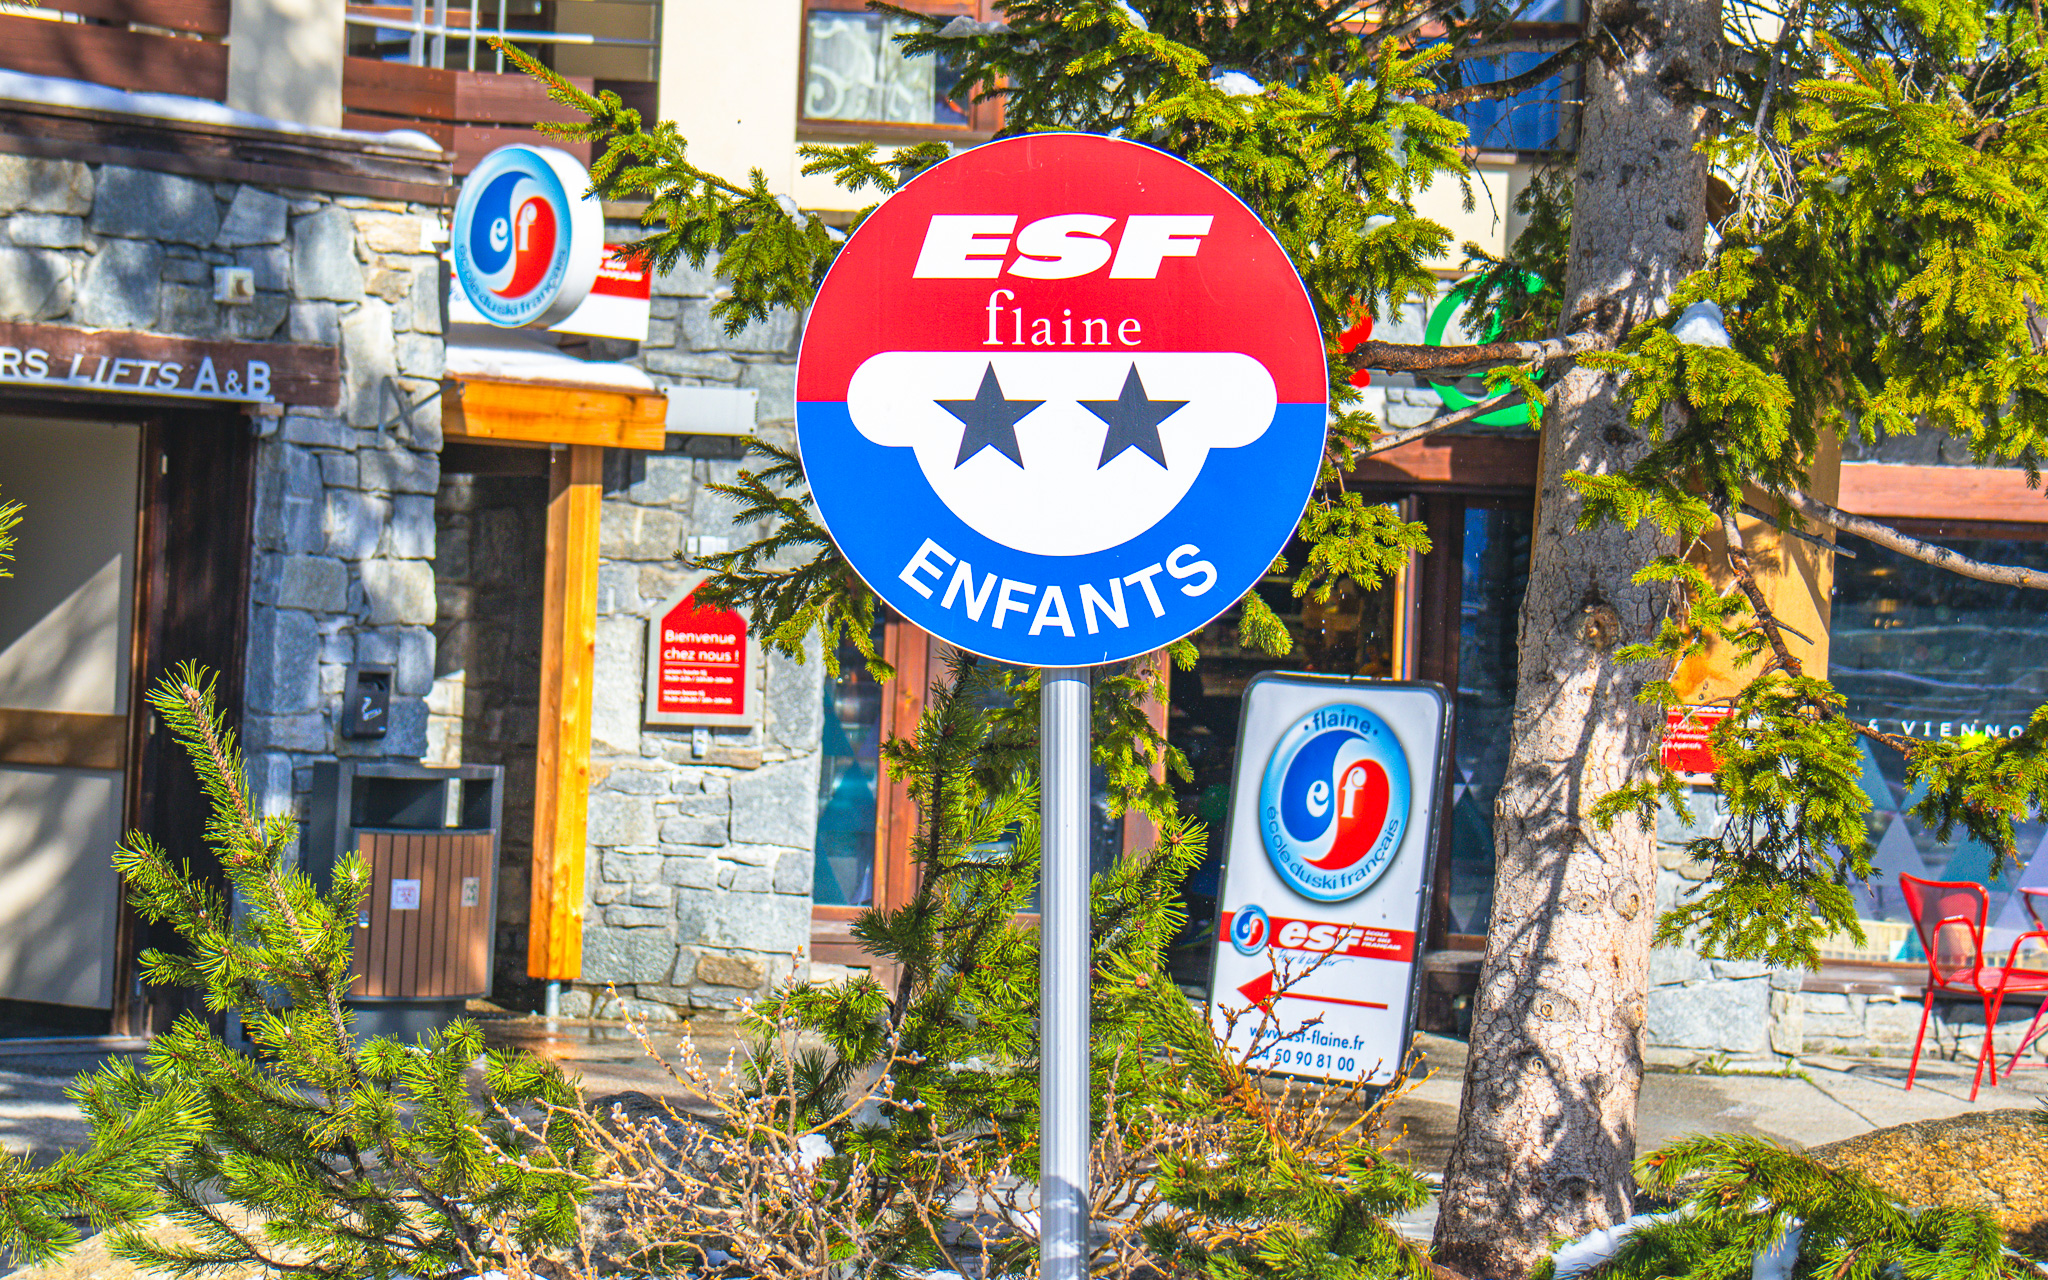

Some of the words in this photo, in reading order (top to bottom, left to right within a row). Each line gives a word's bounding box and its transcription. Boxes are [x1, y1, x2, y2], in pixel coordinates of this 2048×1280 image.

[912, 213, 1214, 280] ESF
[982, 289, 1142, 346] flaine
[68, 353, 184, 390] LIFTS
[898, 537, 1219, 638] ENFANTS
[664, 647, 696, 661] chez
[698, 651, 732, 662] nous
[665, 630, 736, 645] Bienvenue
[1312, 709, 1371, 734] flaine
[1266, 806, 1290, 864] école
[1289, 862, 1310, 883] du
[1312, 874, 1337, 890] ski
[1340, 818, 1399, 888] français
[1275, 1048, 1291, 1064] 50
[1296, 1051, 1312, 1066] 90
[1316, 1054, 1331, 1069] 81
[1338, 1056, 1355, 1072] 00
